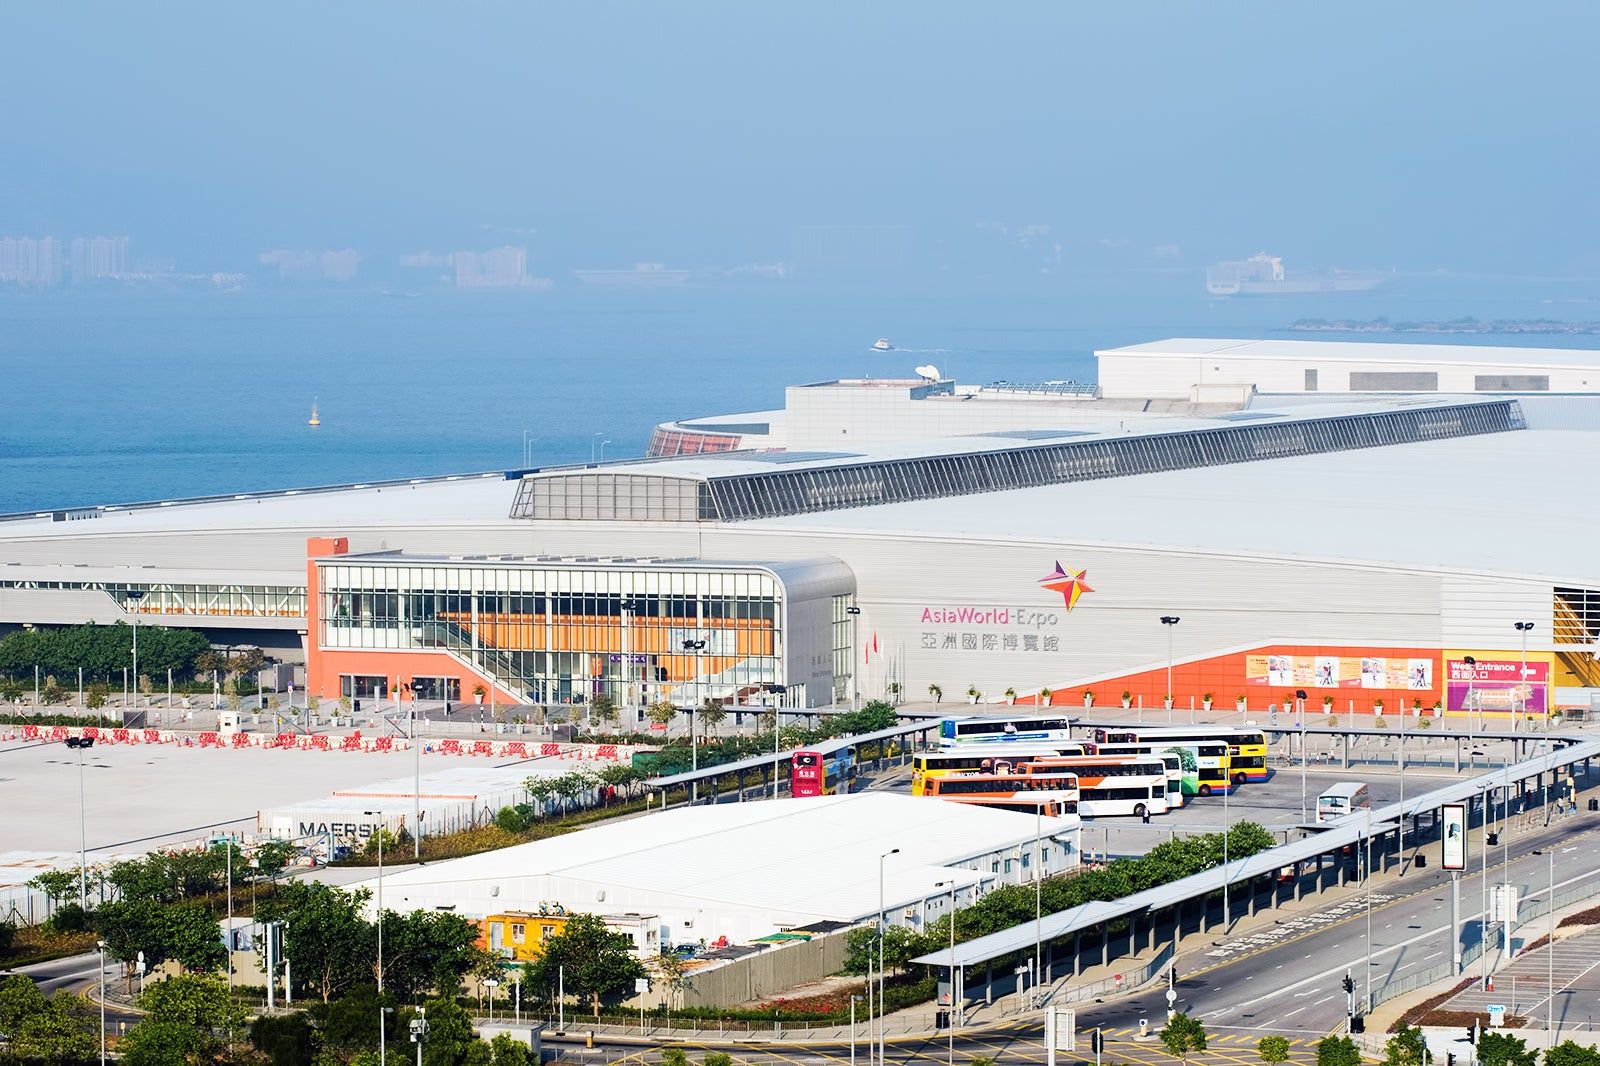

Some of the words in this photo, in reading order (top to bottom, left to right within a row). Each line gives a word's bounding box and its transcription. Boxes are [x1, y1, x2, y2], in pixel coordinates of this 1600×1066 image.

[921, 607, 1058, 629] AsiaWorld-Expo
[921, 632, 1060, 652] 亞洲國際博覽館
[1451, 670, 1489, 679] 西面入口
[1475, 662, 1516, 672] Entrance
